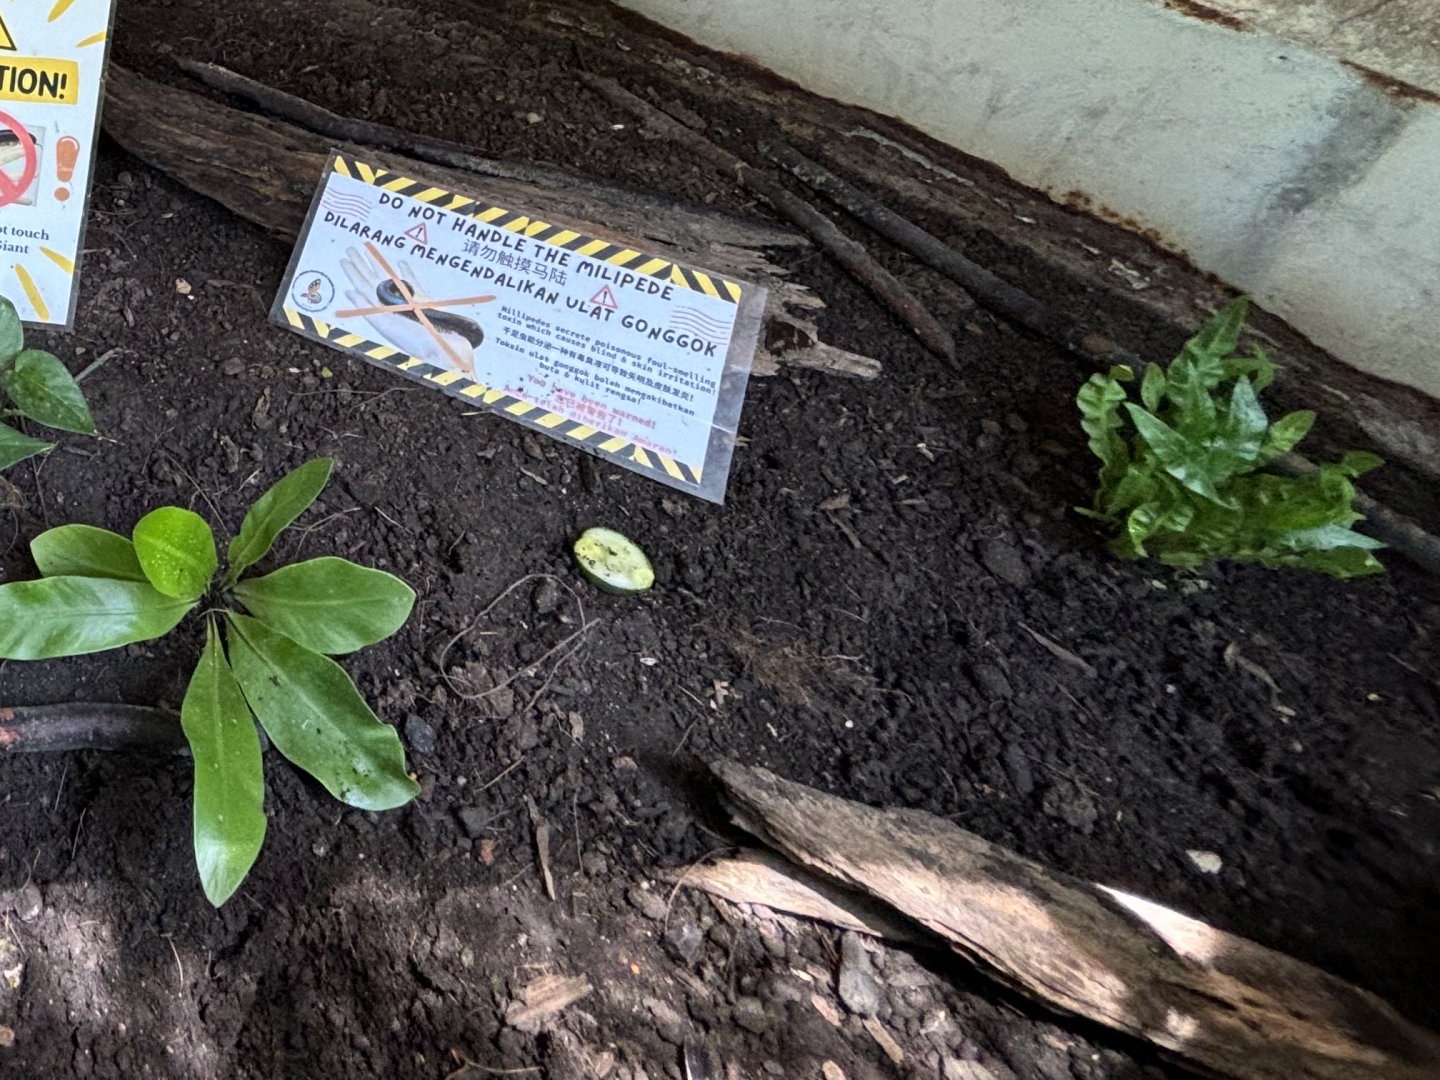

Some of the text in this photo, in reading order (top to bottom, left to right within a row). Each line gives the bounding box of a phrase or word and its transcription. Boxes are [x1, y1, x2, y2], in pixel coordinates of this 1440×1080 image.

[11, 224, 50, 241] touch
[379, 192, 675, 301] DO NOT HANDLE THE MILIPEDE
[462, 238, 568, 286] 请勿触摸马陆
[324, 211, 718, 357] DILARANG MENGENDALIKAN ULAT GONGGOK
[495, 337, 696, 416] Toksin ulat gonggok boleh mengakibatkan
[497, 312, 522, 326] toxin
[526, 323, 552, 337] which
[555, 334, 586, 349] causes
[591, 345, 617, 360] blind
[632, 360, 653, 373] skin
[658, 368, 717, 396] irritation!
[501, 305, 717, 389] Millipedes secrete poisonous foul-smelling
[539, 362, 560, 375] buta
[574, 375, 600, 390] kulit
[605, 387, 641, 405] rengsa!
